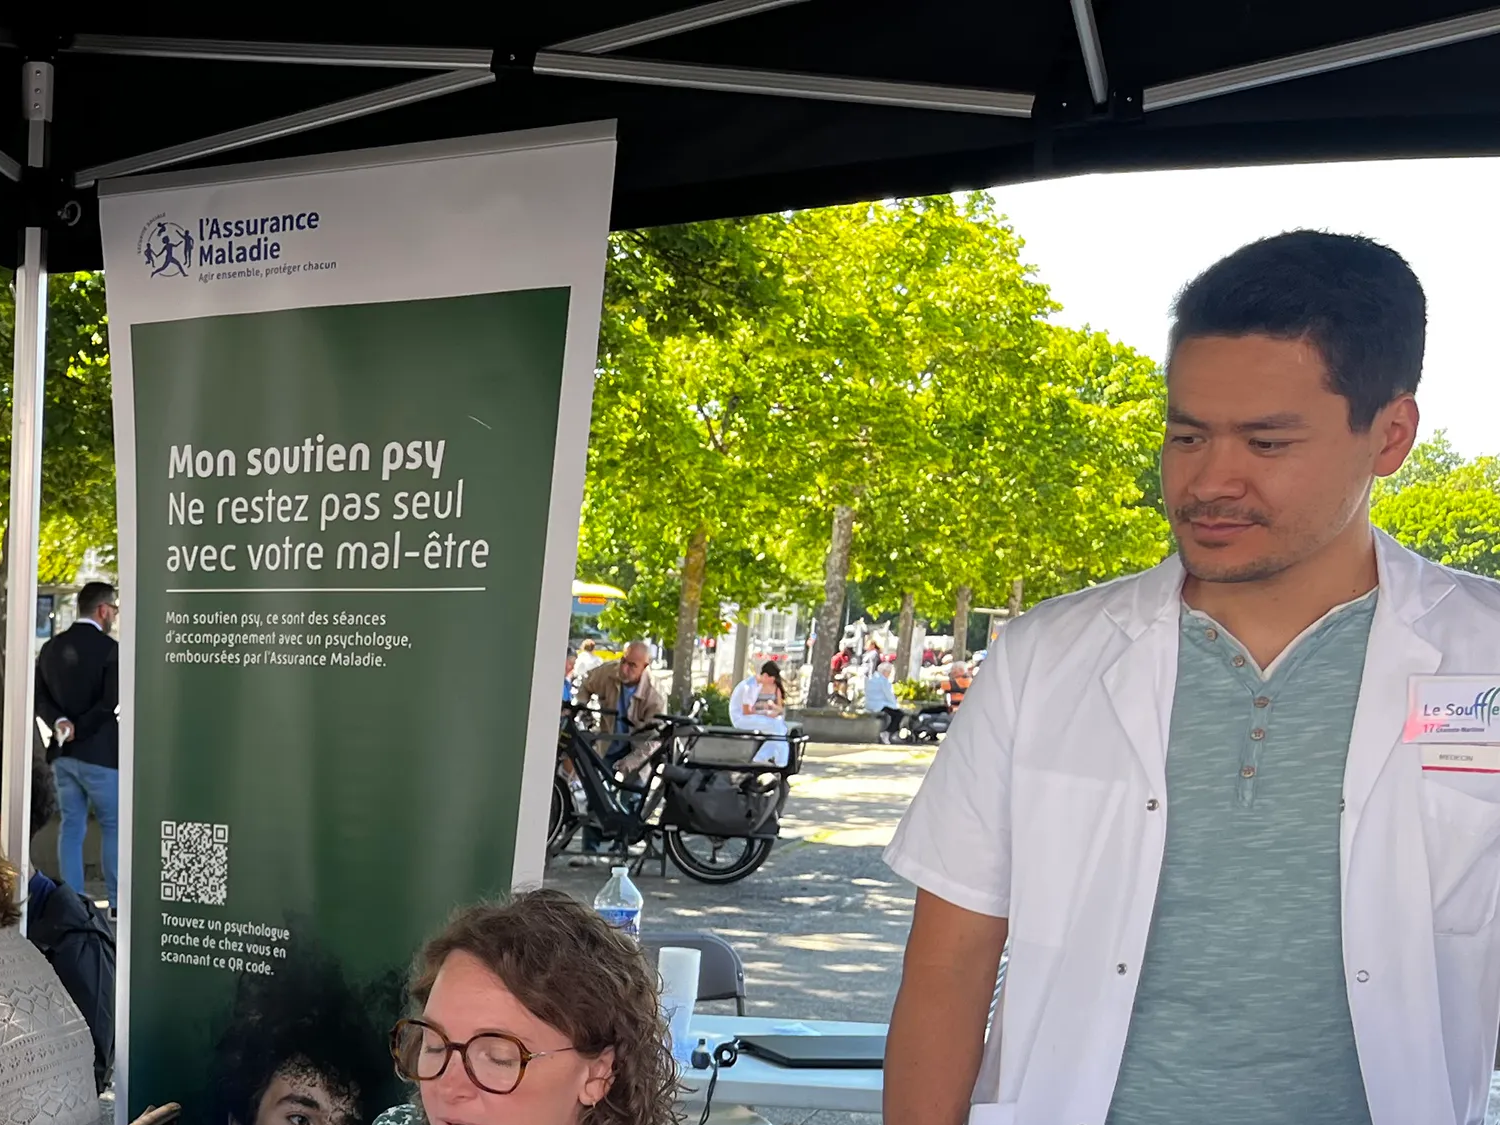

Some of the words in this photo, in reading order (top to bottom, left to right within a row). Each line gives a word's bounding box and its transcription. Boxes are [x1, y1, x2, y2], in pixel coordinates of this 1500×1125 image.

[198, 211, 320, 241] l'Assurance
[198, 236, 282, 267] Maladie
[197, 271, 214, 284] Agir
[216, 266, 264, 281] ensemble,
[265, 262, 301, 278] protéger
[303, 260, 337, 272] chacun
[168, 444, 236, 479] Mon
[246, 433, 370, 476] soutien
[381, 439, 446, 481] psy
[168, 491, 204, 526] Ne
[217, 488, 309, 524] restez
[320, 491, 381, 531] pas
[392, 478, 463, 521] seul
[166, 543, 236, 572] avec
[247, 535, 323, 571] votre
[336, 530, 490, 570] mal-être
[165, 610, 190, 625] Mon
[192, 610, 238, 625] soutien
[241, 612, 263, 628] psy,
[266, 613, 279, 625] ce
[281, 611, 305, 625] sont
[308, 611, 329, 625] des
[332, 611, 387, 626] séances
[165, 630, 276, 648] d'accompagnement
[278, 633, 303, 646] avec
[306, 634, 322, 646] un
[325, 631, 413, 650] psychologue,
[165, 650, 241, 665] remboursées
[243, 653, 261, 667] par
[264, 651, 327, 666] l'Assurance
[330, 652, 387, 667] Maladie.
[1424, 703, 1441, 717] Le
[1445, 687, 1500, 727] Souffle
[1423, 724, 1435, 734] 17
[161, 912, 206, 929] Trouvez
[207, 920, 222, 932] un
[223, 921, 291, 942] psychologue
[161, 933, 200, 947] proche
[202, 935, 216, 949] de
[218, 937, 244, 953] chez
[245, 943, 271, 957] vous
[273, 947, 287, 959] en
[160, 951, 210, 967] scannant
[212, 957, 226, 969] ce
[228, 957, 244, 972] QR
[245, 961, 275, 976] code.
